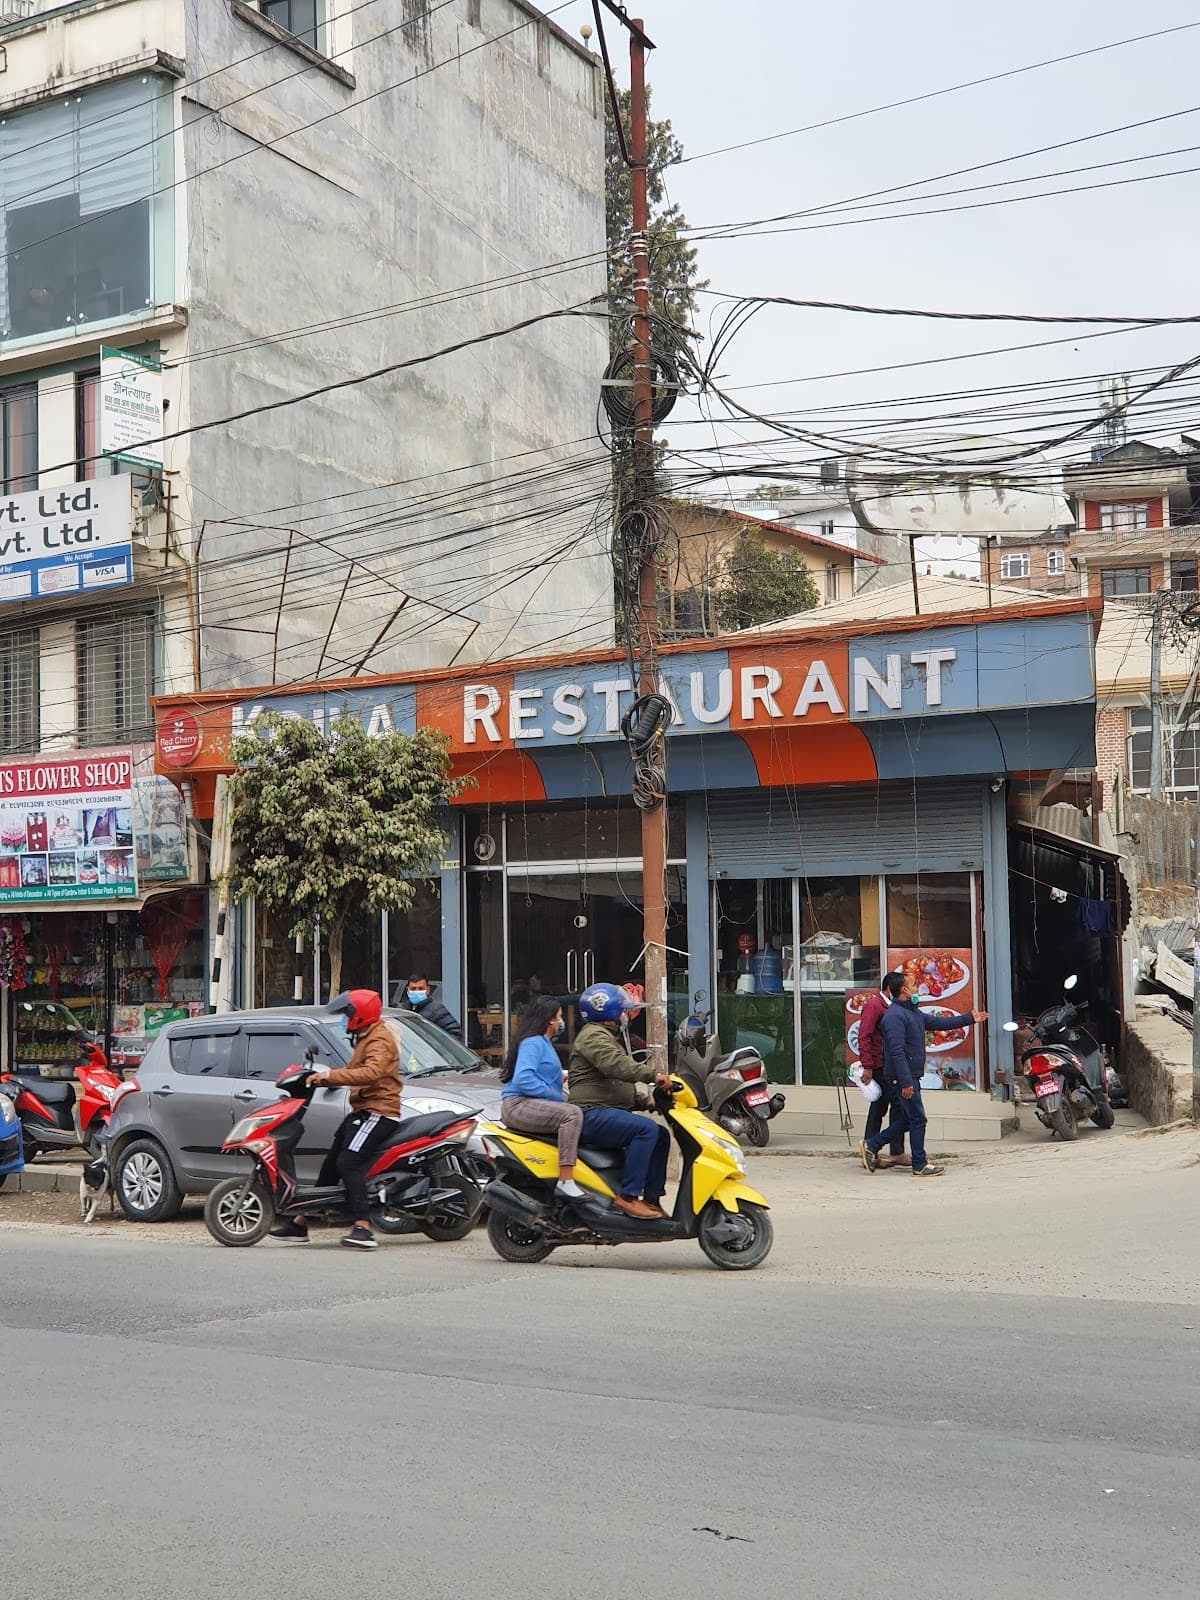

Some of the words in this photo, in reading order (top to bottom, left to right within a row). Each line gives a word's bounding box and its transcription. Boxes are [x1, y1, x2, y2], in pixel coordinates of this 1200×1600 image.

[0, 501, 26, 523] t.
[38, 487, 99, 517] Ltd.
[43, 519, 100, 548] Ltd.
[64, 554, 73, 562] We
[95, 566, 115, 577] VISA
[160, 737, 173, 746] Red
[174, 735, 197, 745] Cherry
[17, 765, 82, 792] FLOWER
[85, 761, 129, 787] SHOP
